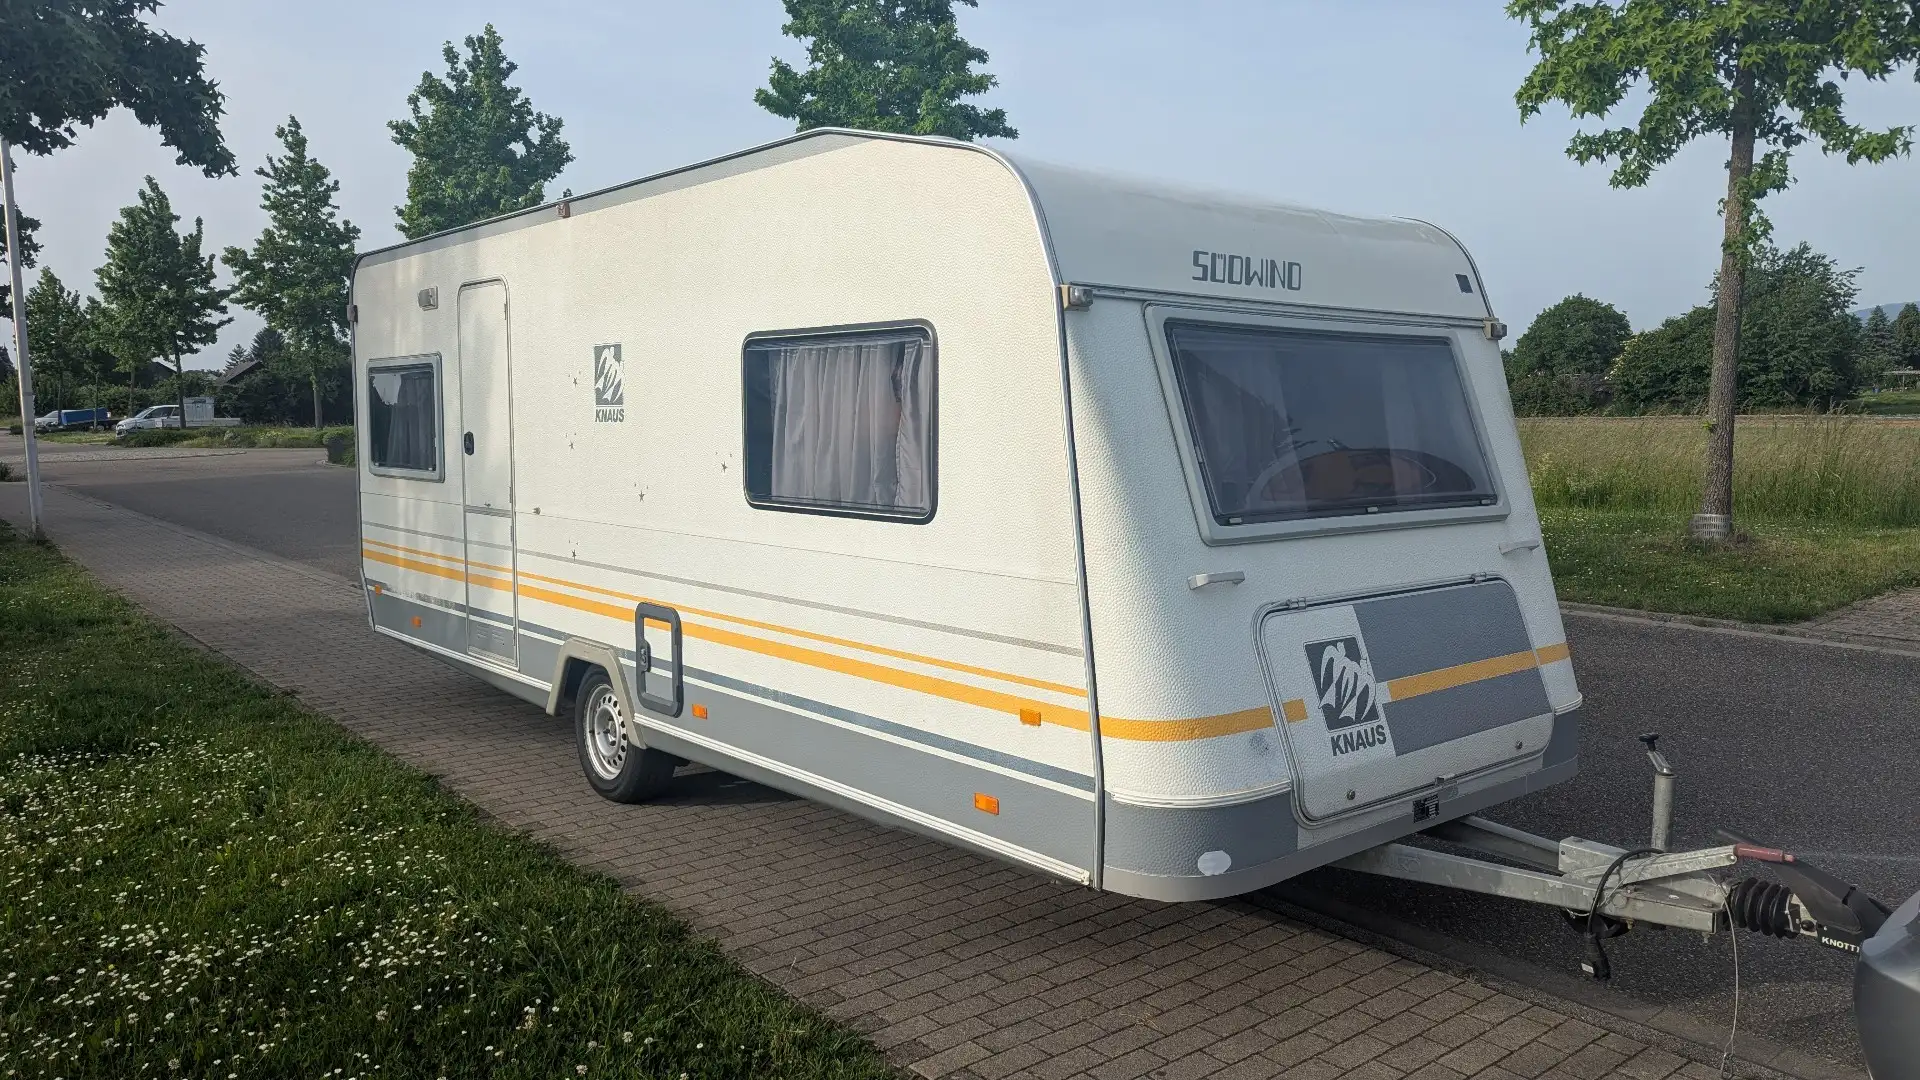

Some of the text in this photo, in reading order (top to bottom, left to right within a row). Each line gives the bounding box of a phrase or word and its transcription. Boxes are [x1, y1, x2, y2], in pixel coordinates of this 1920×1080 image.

[1192, 250, 1302, 291] SÜDWIND
[595, 408, 625, 423] KNAUS
[1331, 724, 1387, 757] KNAUS
